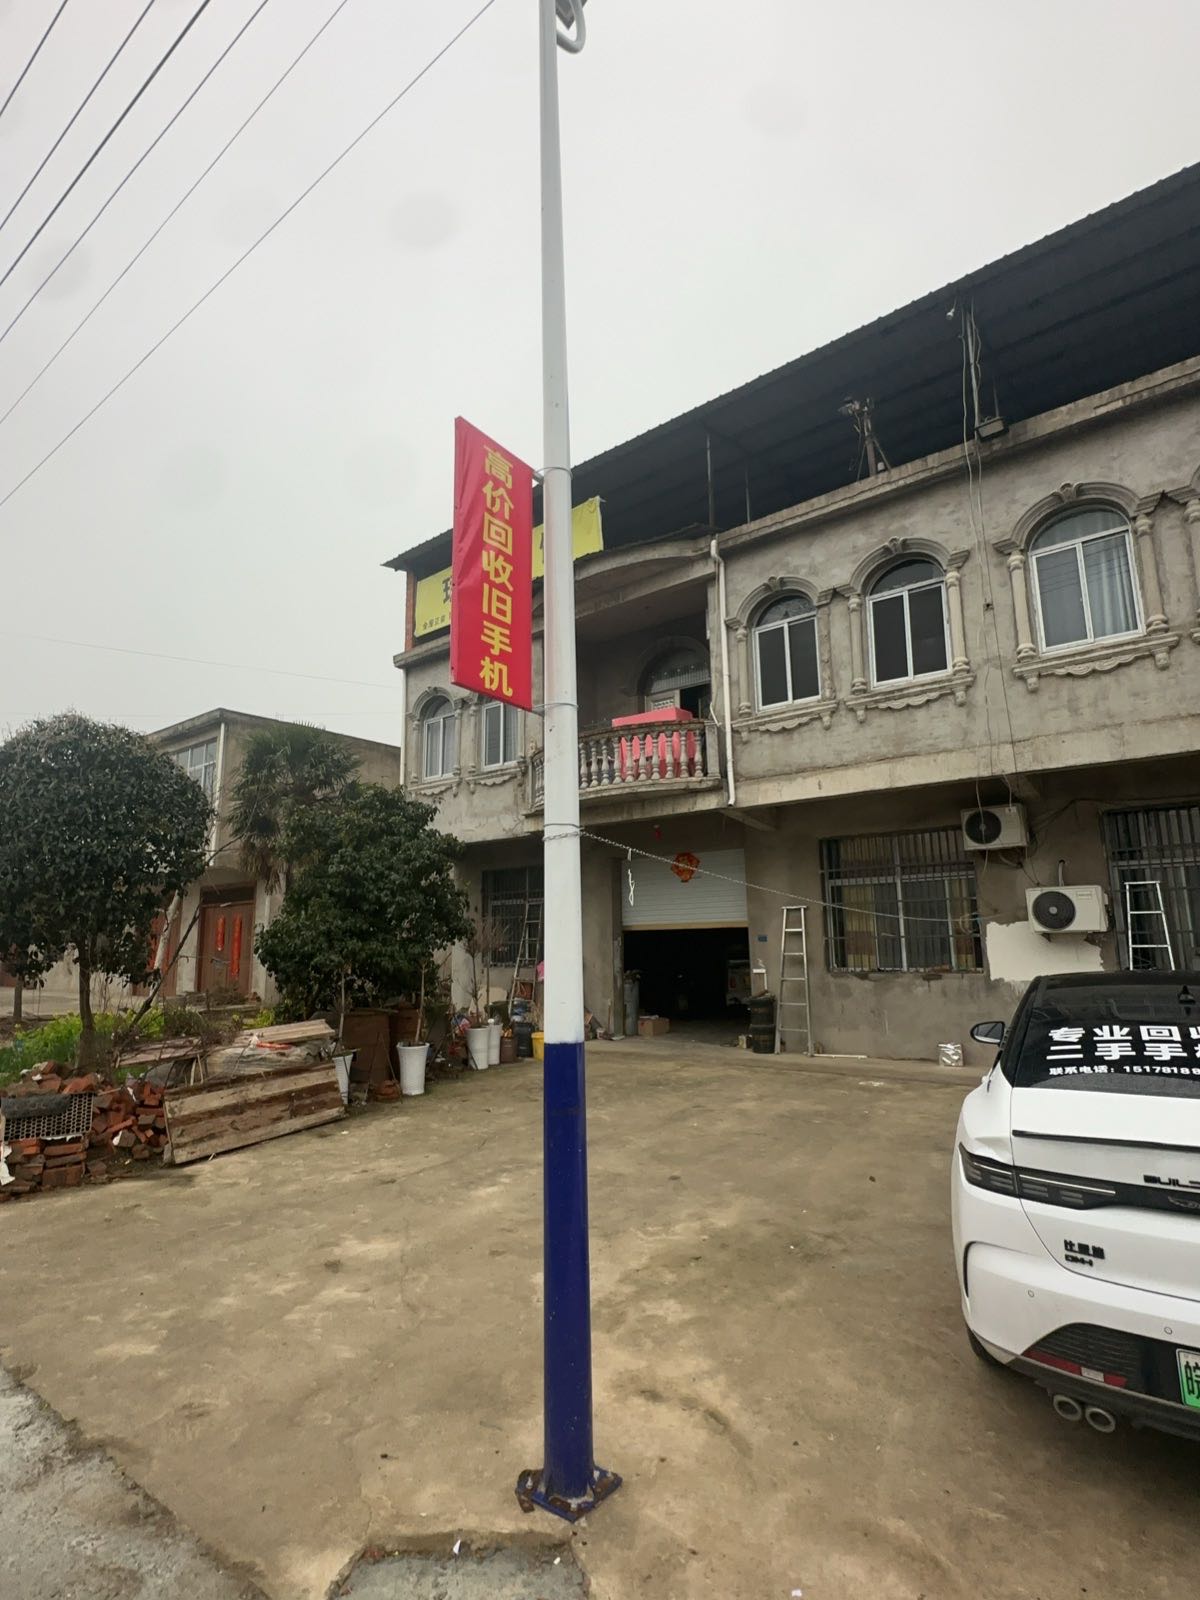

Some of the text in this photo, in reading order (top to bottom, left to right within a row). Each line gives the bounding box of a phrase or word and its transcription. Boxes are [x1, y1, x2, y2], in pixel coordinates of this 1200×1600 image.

[479, 445, 514, 698] 高价回收旧手机
